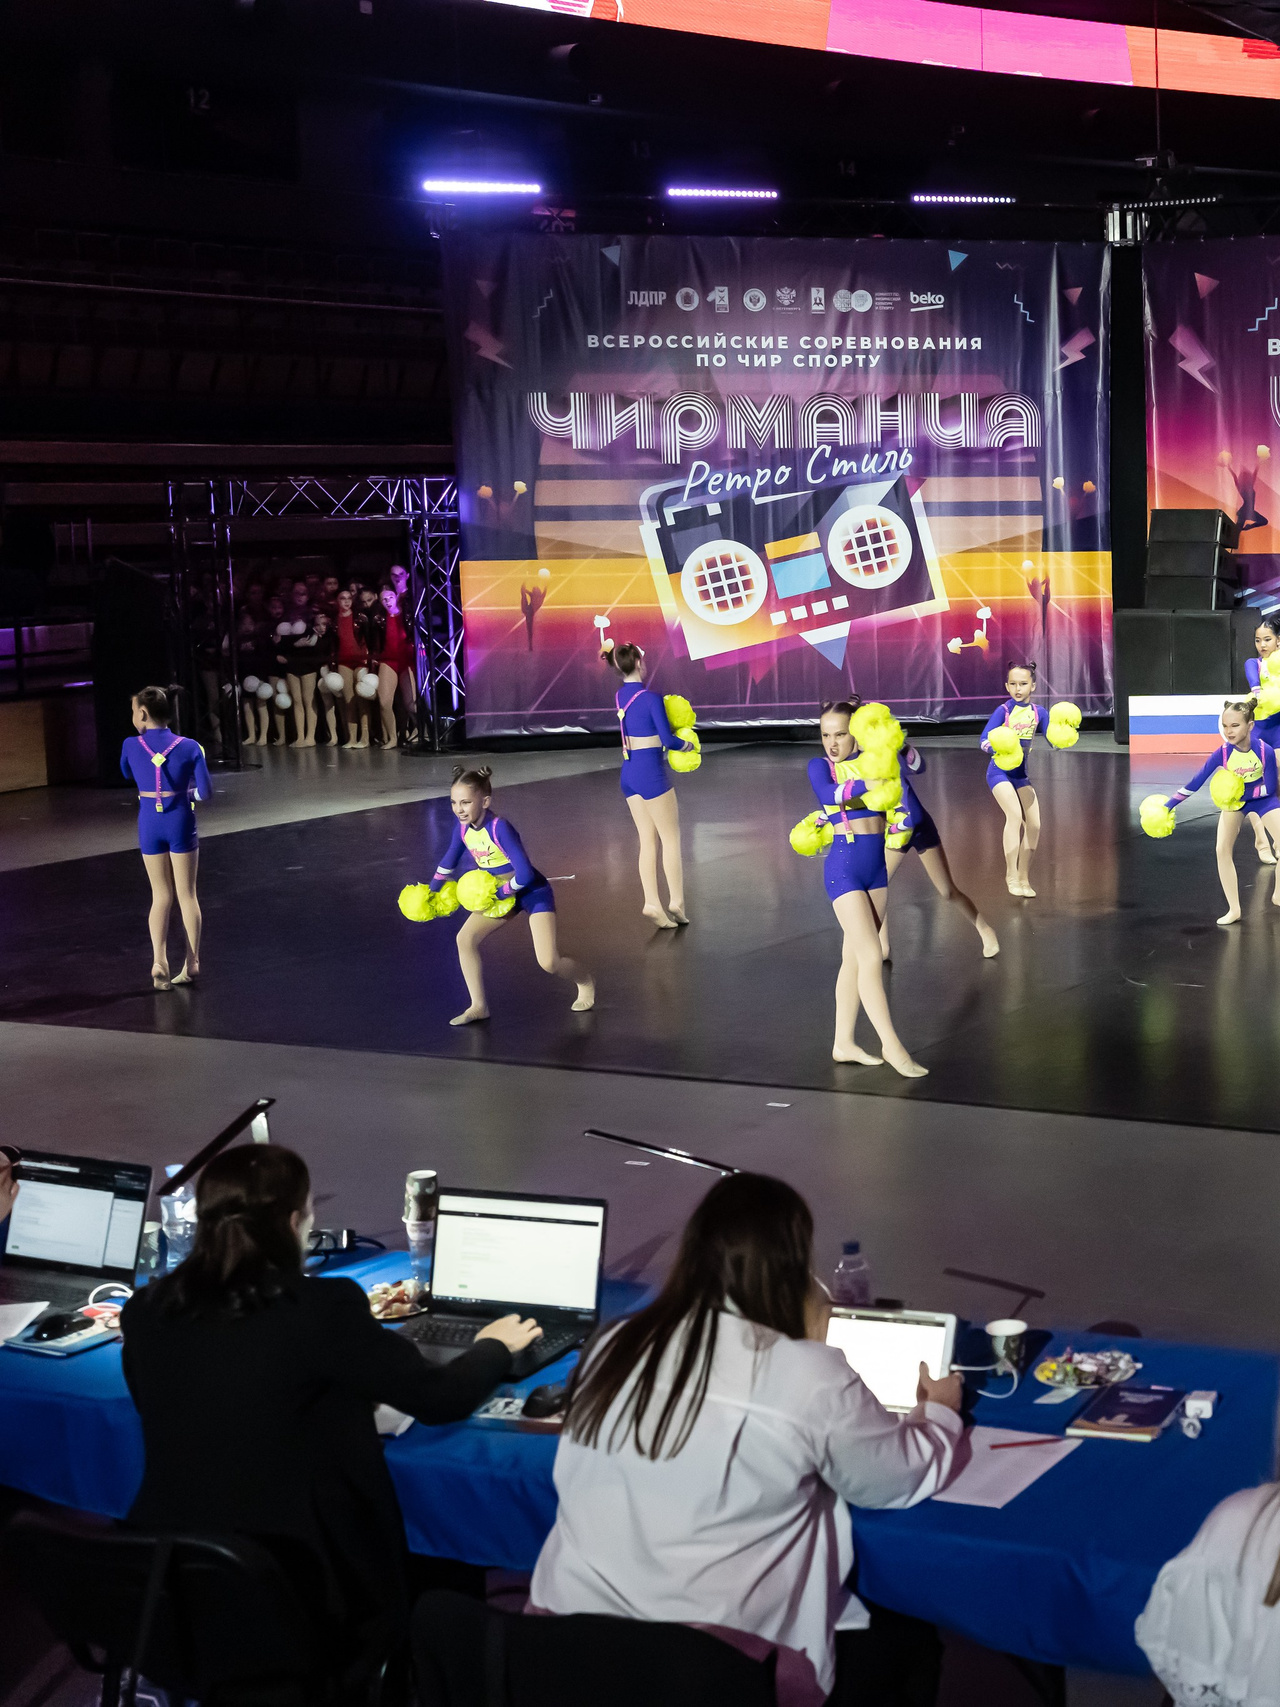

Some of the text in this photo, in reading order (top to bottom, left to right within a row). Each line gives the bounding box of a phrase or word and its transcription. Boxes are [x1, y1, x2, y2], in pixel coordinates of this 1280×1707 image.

[185, 87, 211, 110] 12
[627, 290, 667, 307] ЛДПР
[910, 291, 945, 304] beko
[587, 333, 984, 351] ВСЕРОССИЙСКИЕ СОРЕВНОВАНИЯ
[696, 353, 882, 369] ПО ЧИР СПОРТУ
[682, 444, 914, 503] Ретро Стиль
